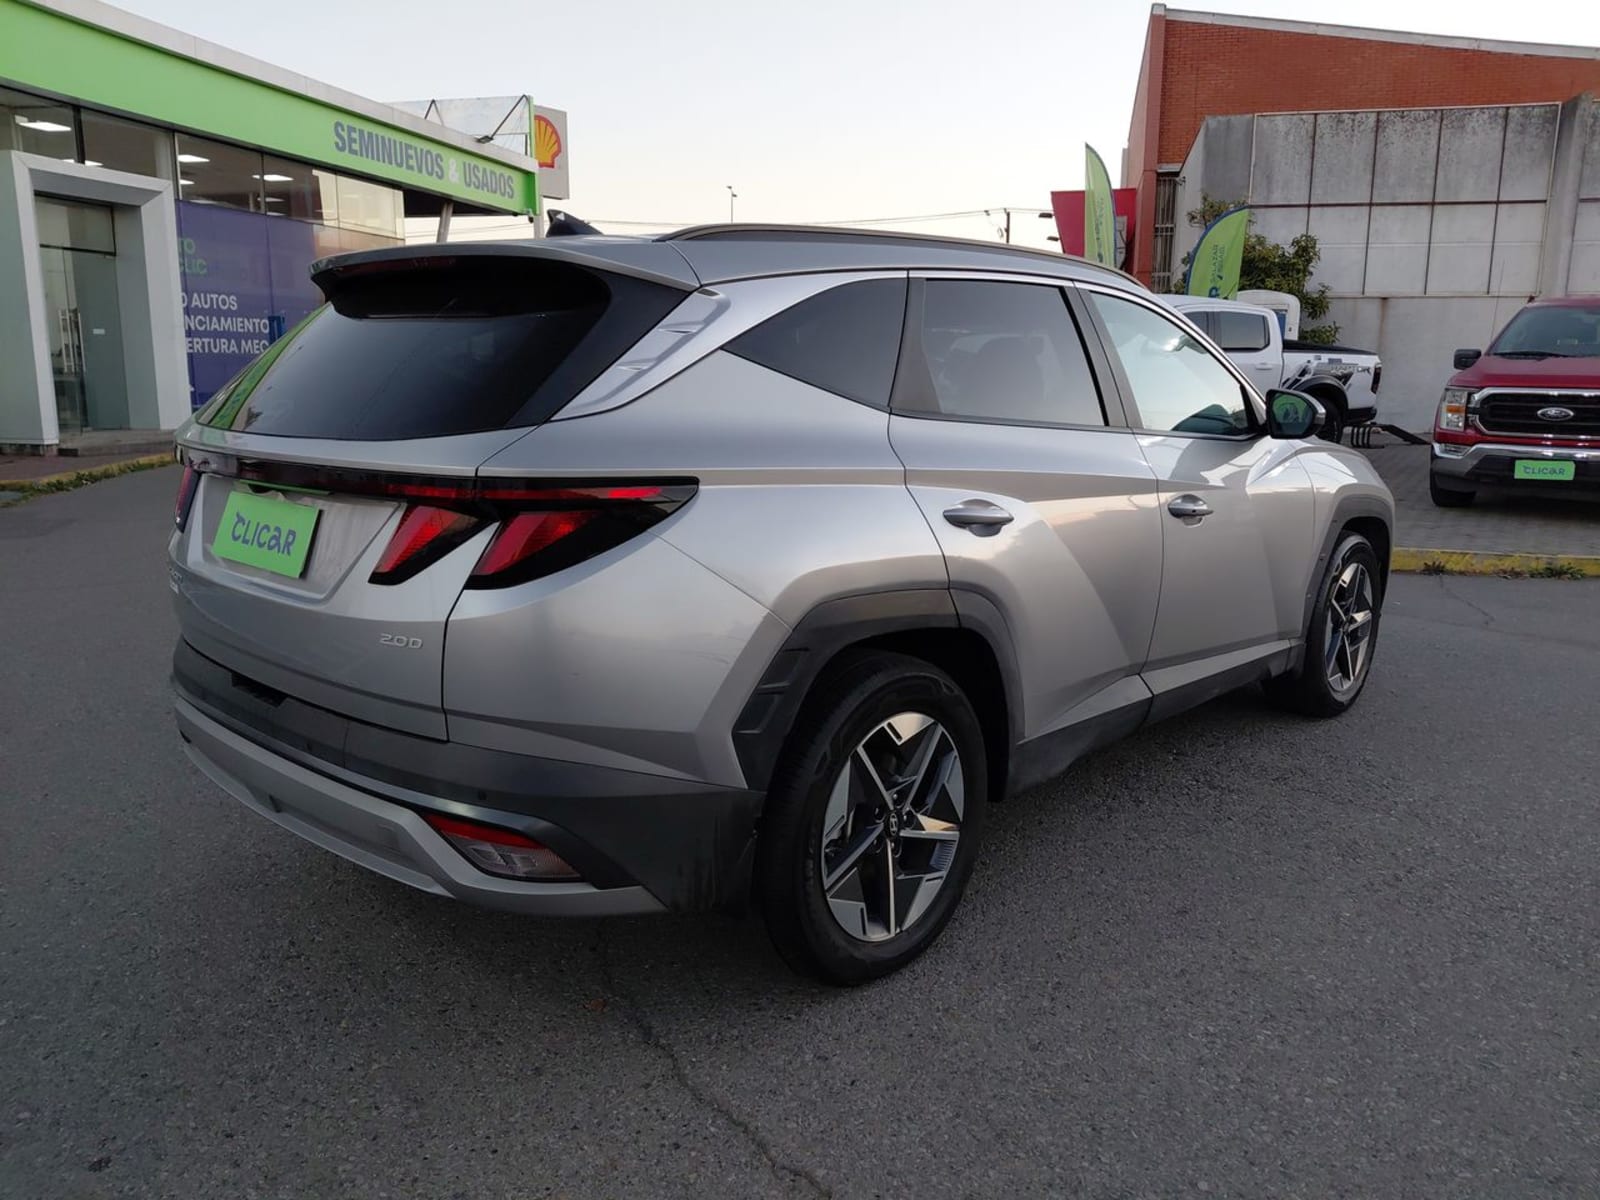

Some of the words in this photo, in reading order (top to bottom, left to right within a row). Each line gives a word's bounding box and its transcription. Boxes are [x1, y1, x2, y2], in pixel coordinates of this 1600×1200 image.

[333, 120, 444, 180] SEMINUEVOS
[449, 160, 459, 182] &
[463, 161, 515, 199] USADOS
[191, 292, 238, 311] AUTOS
[186, 337, 239, 354] ERTURA
